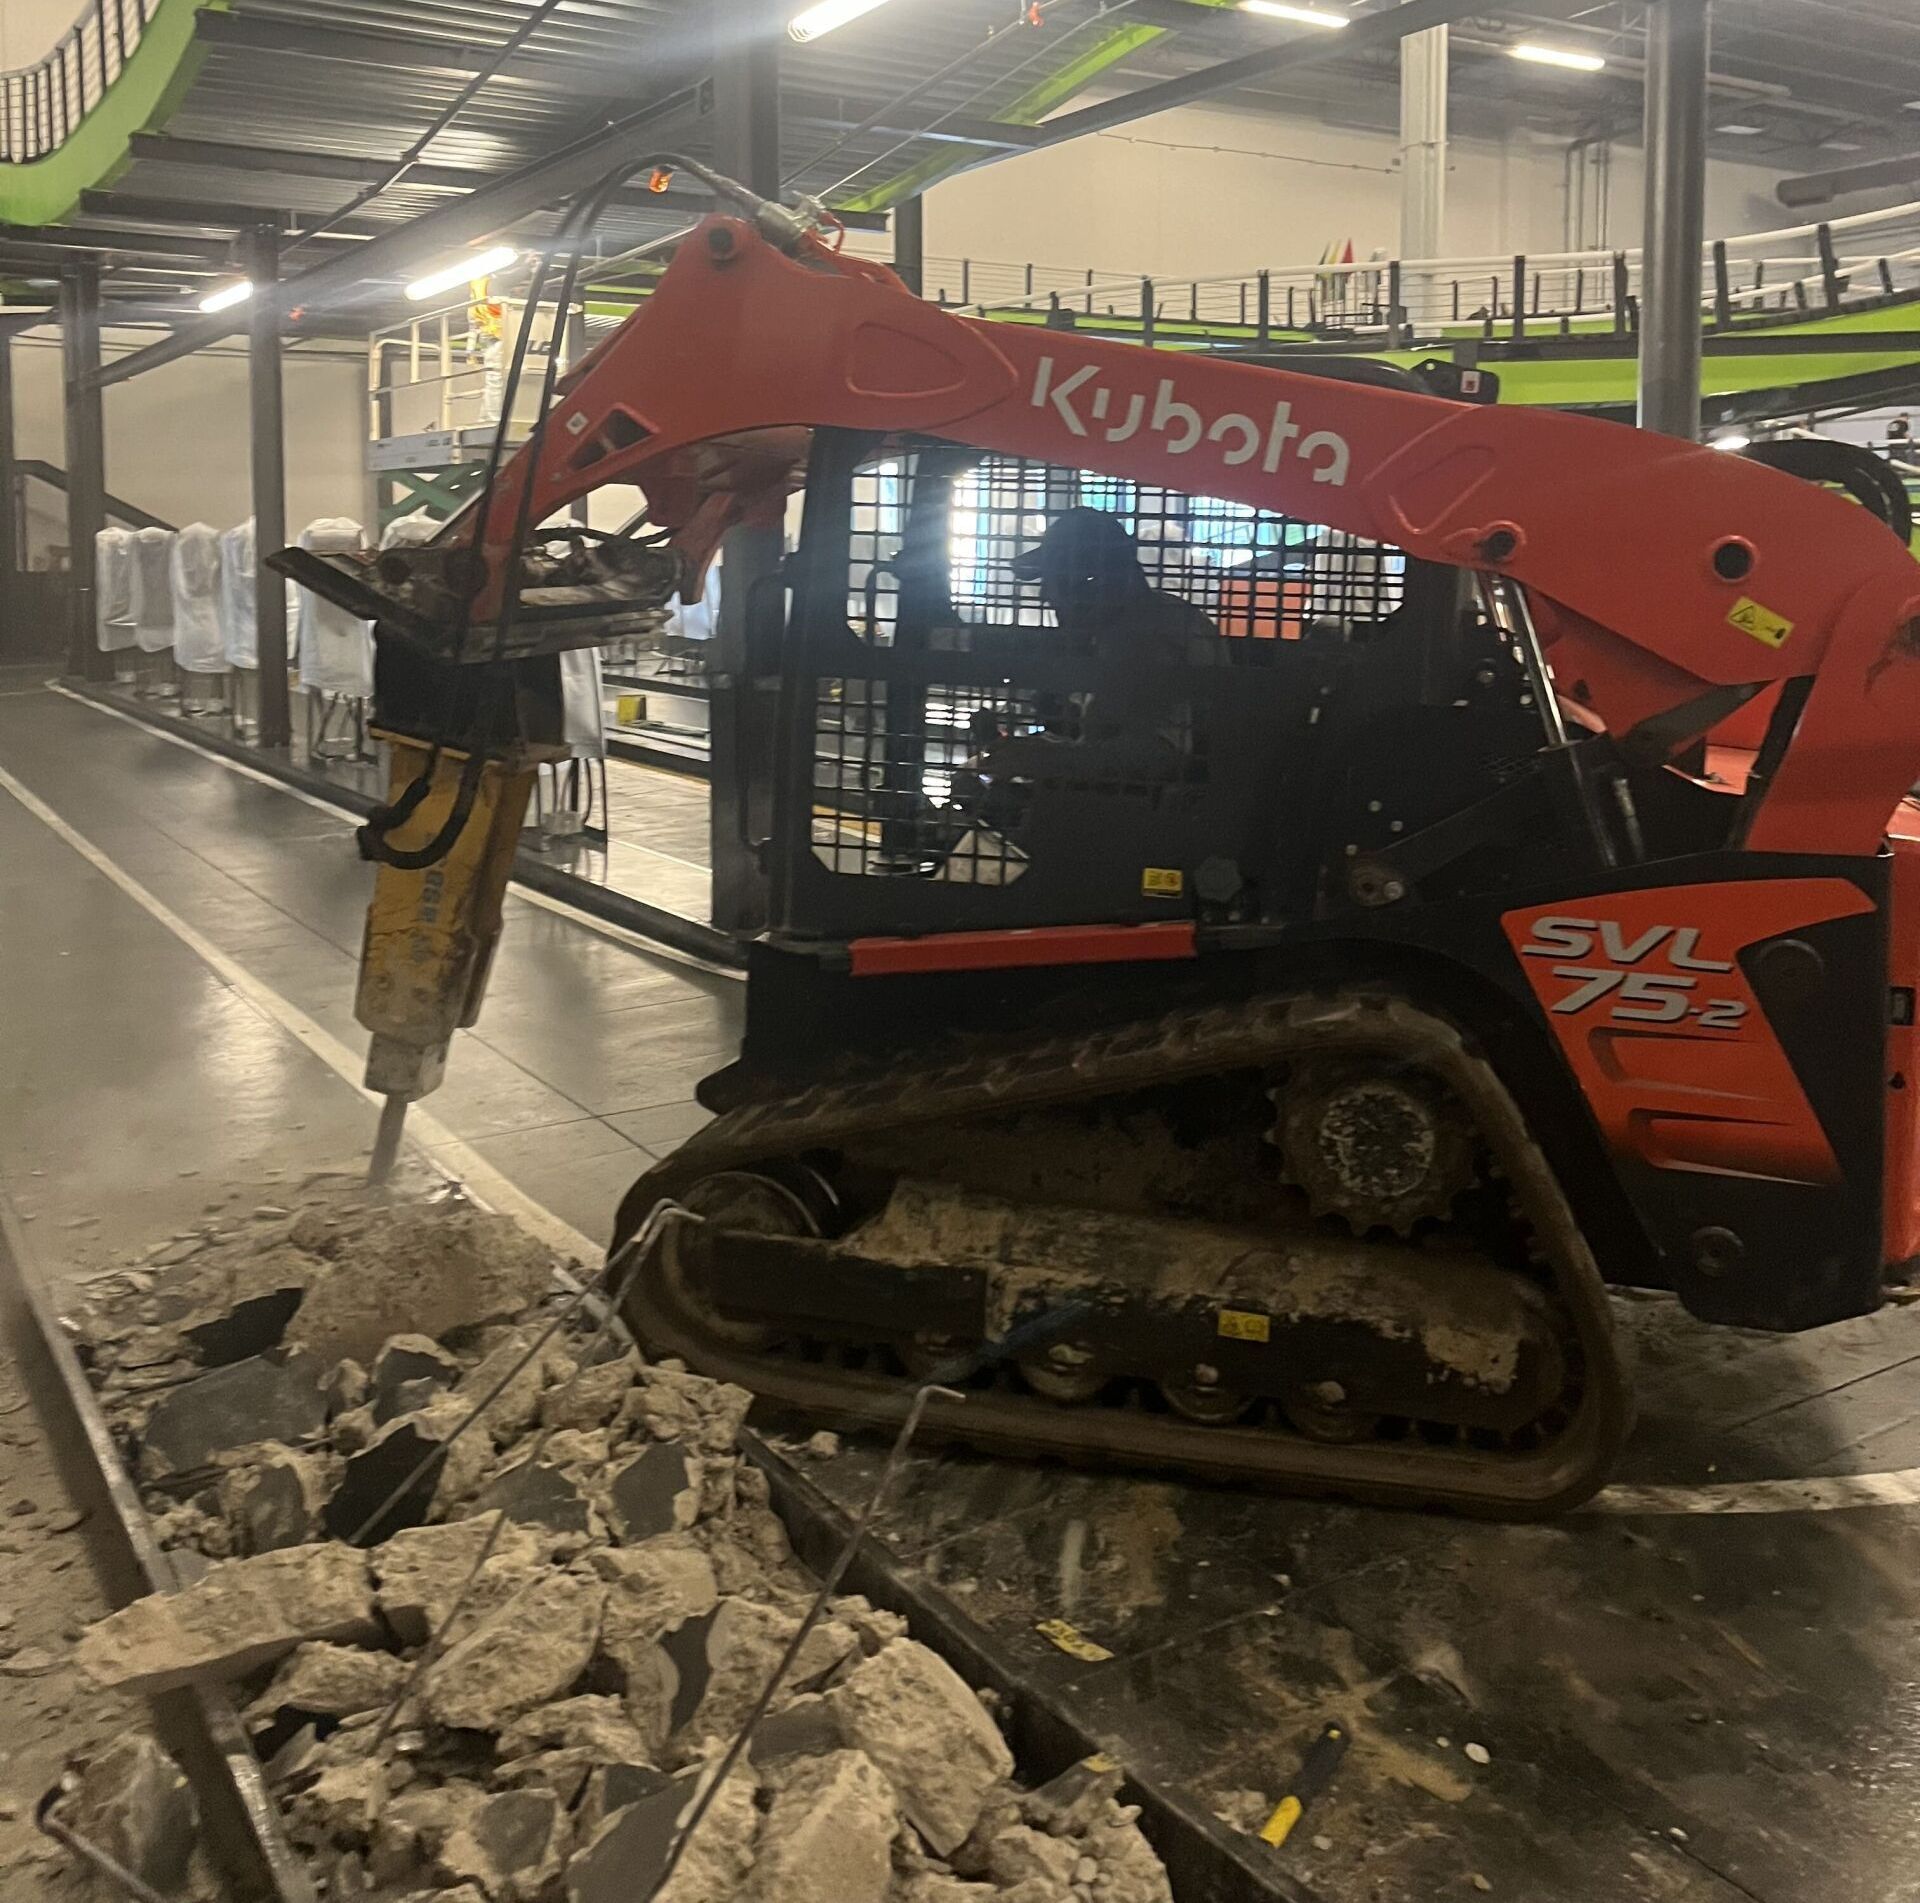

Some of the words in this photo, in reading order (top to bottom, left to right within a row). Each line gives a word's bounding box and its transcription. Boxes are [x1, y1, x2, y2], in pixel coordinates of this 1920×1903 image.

[1031, 357, 1350, 486] Kubota
[1522, 916, 1734, 971] SVL
[1551, 966, 1748, 1028] 75-2
